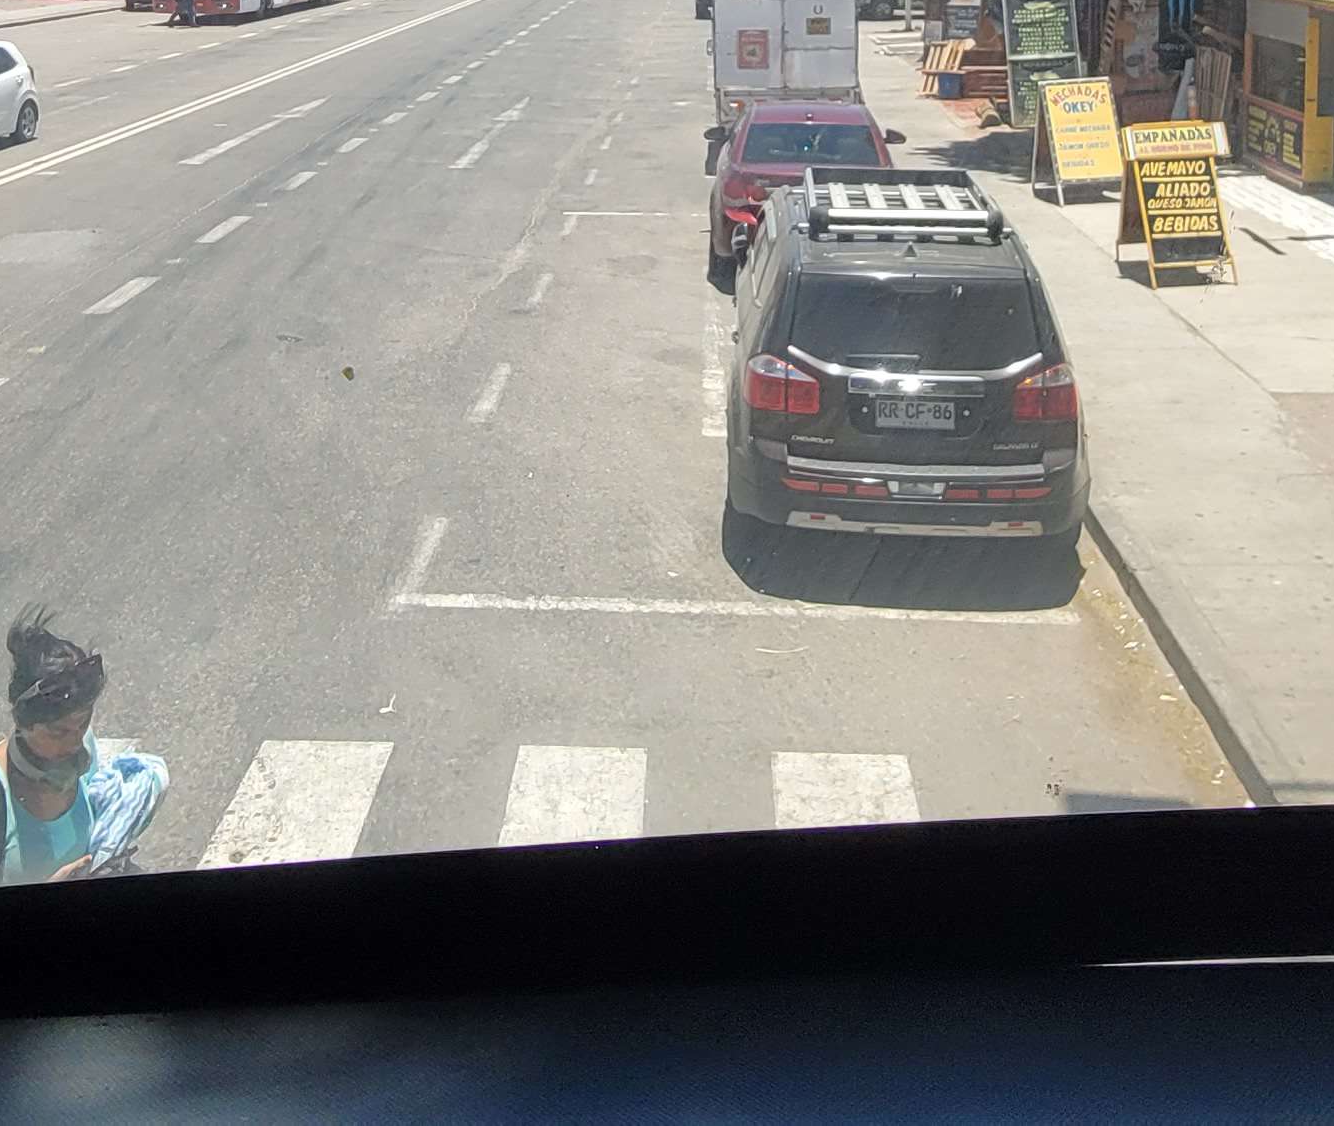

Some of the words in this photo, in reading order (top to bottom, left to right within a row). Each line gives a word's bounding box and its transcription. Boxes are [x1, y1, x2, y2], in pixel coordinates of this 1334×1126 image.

[1050, 85, 1107, 107] MECHADAS
[1063, 101, 1094, 113] OKEY
[1134, 128, 1212, 144] EMPANADAS
[1155, 182, 1211, 197] ALIADO
[1147, 198, 1183, 209] QUESO
[1153, 215, 1219, 232] BEBIDAS
